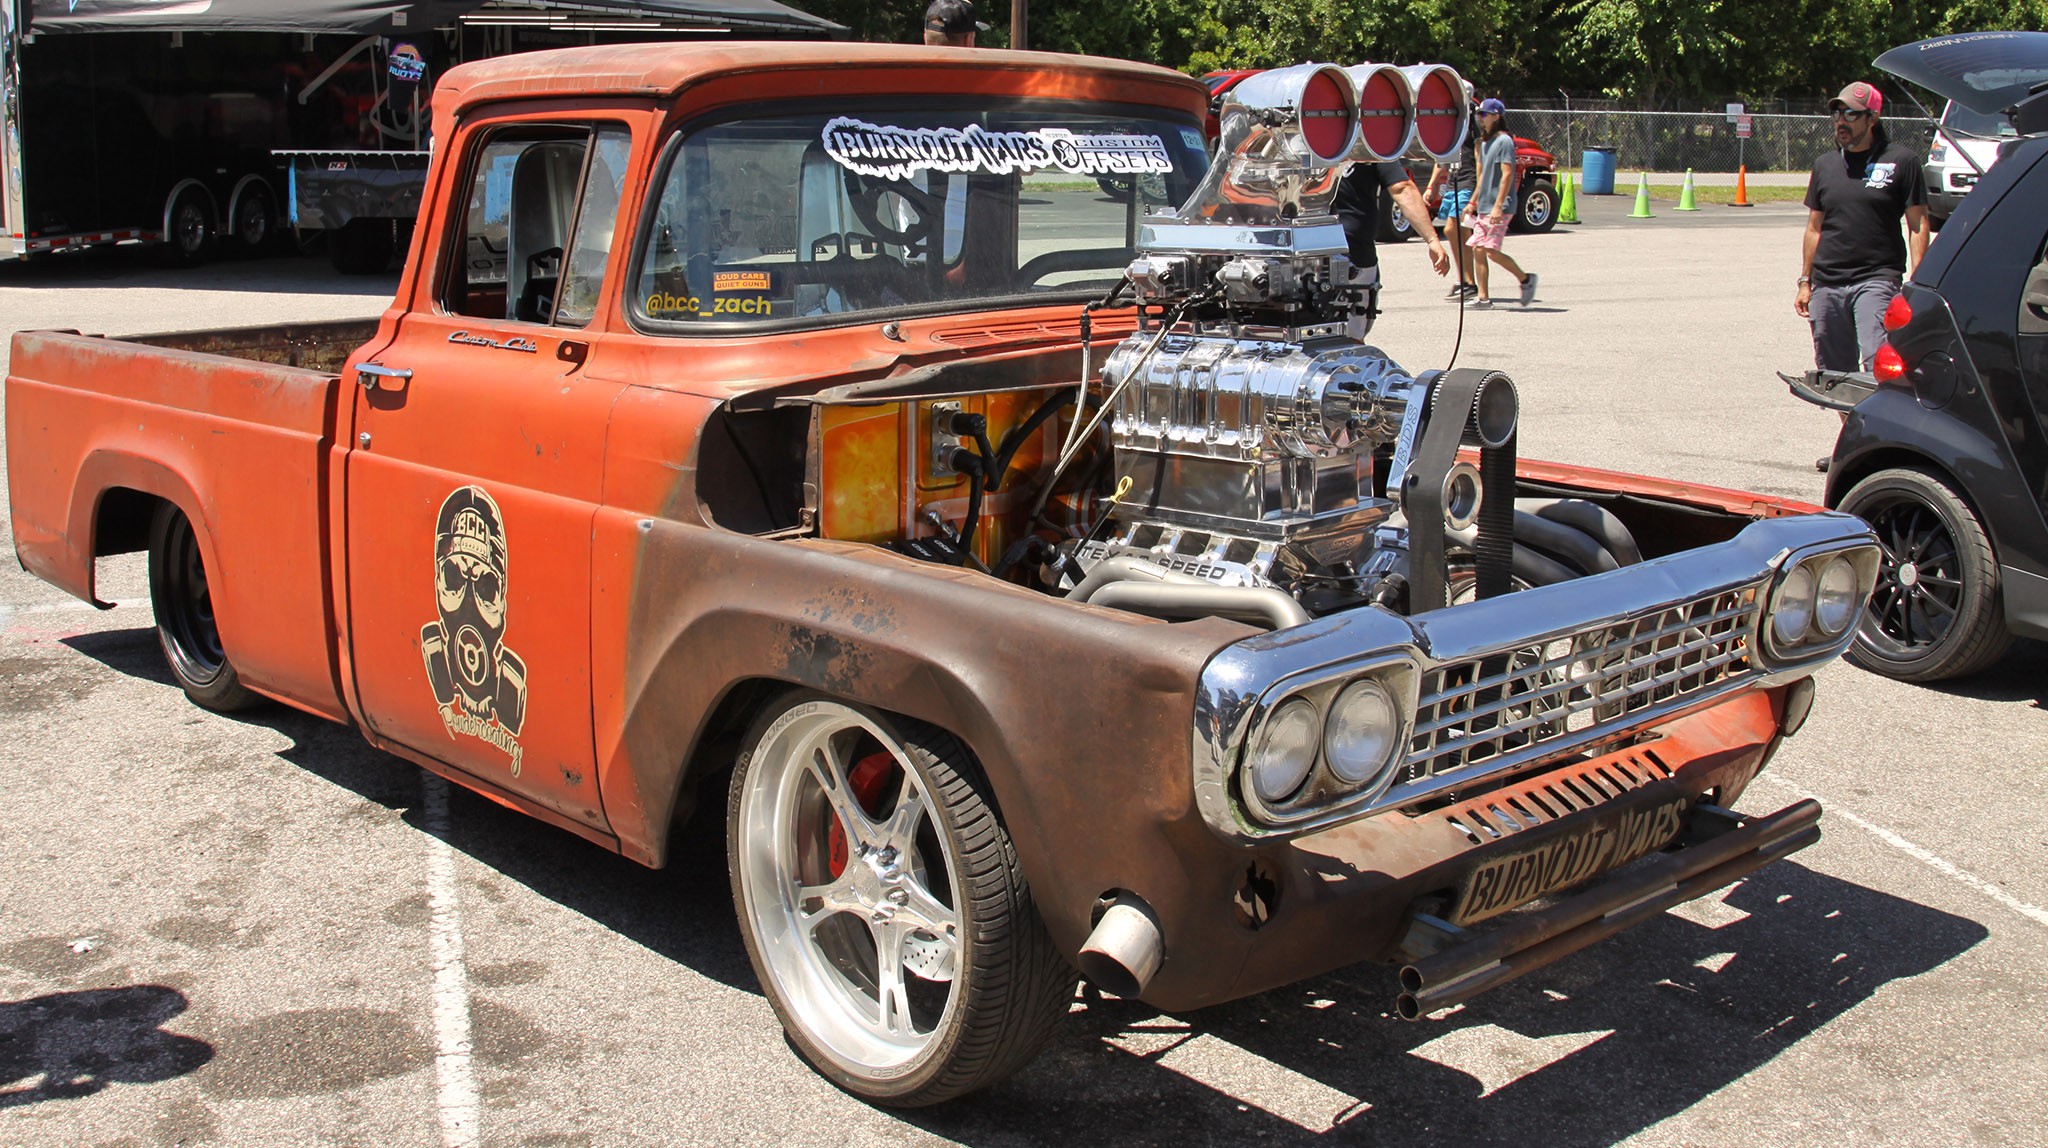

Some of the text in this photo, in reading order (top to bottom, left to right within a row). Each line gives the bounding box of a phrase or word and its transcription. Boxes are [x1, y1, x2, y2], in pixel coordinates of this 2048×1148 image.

[967, 129, 1049, 169] WARS
[1074, 138, 1160, 148] CUSTOM
[646, 292, 771, 317] @bcc_zach
[448, 330, 536, 353] Custom Cab
[1396, 403, 1419, 468] BDS
[456, 511, 486, 542] BCC
[758, 702, 818, 752] FORGED
[1461, 798, 1687, 920] BURNOUT WARS
[869, 1043, 935, 1079] FORGED
